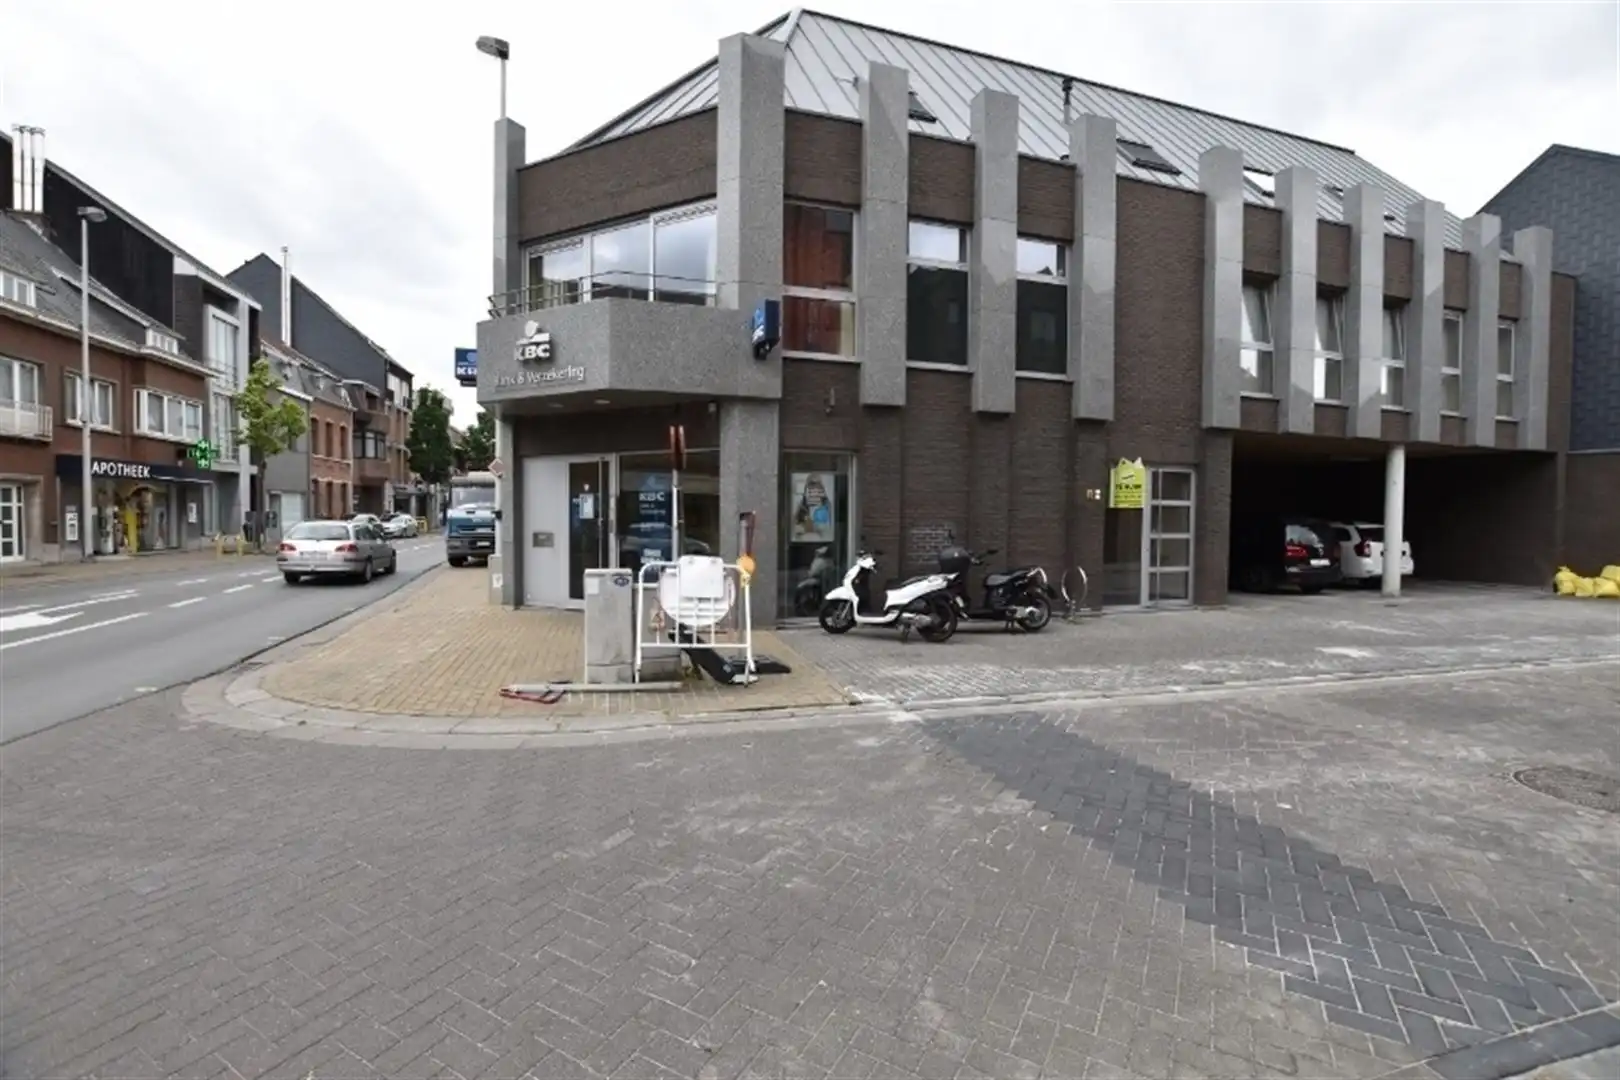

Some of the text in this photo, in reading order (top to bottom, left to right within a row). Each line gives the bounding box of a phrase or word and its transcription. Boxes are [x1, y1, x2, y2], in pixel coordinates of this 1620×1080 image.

[513, 343, 551, 361] KBC
[456, 366, 478, 376] KB
[91, 461, 150, 478] APOTHEEK
[638, 491, 665, 502] KBC
